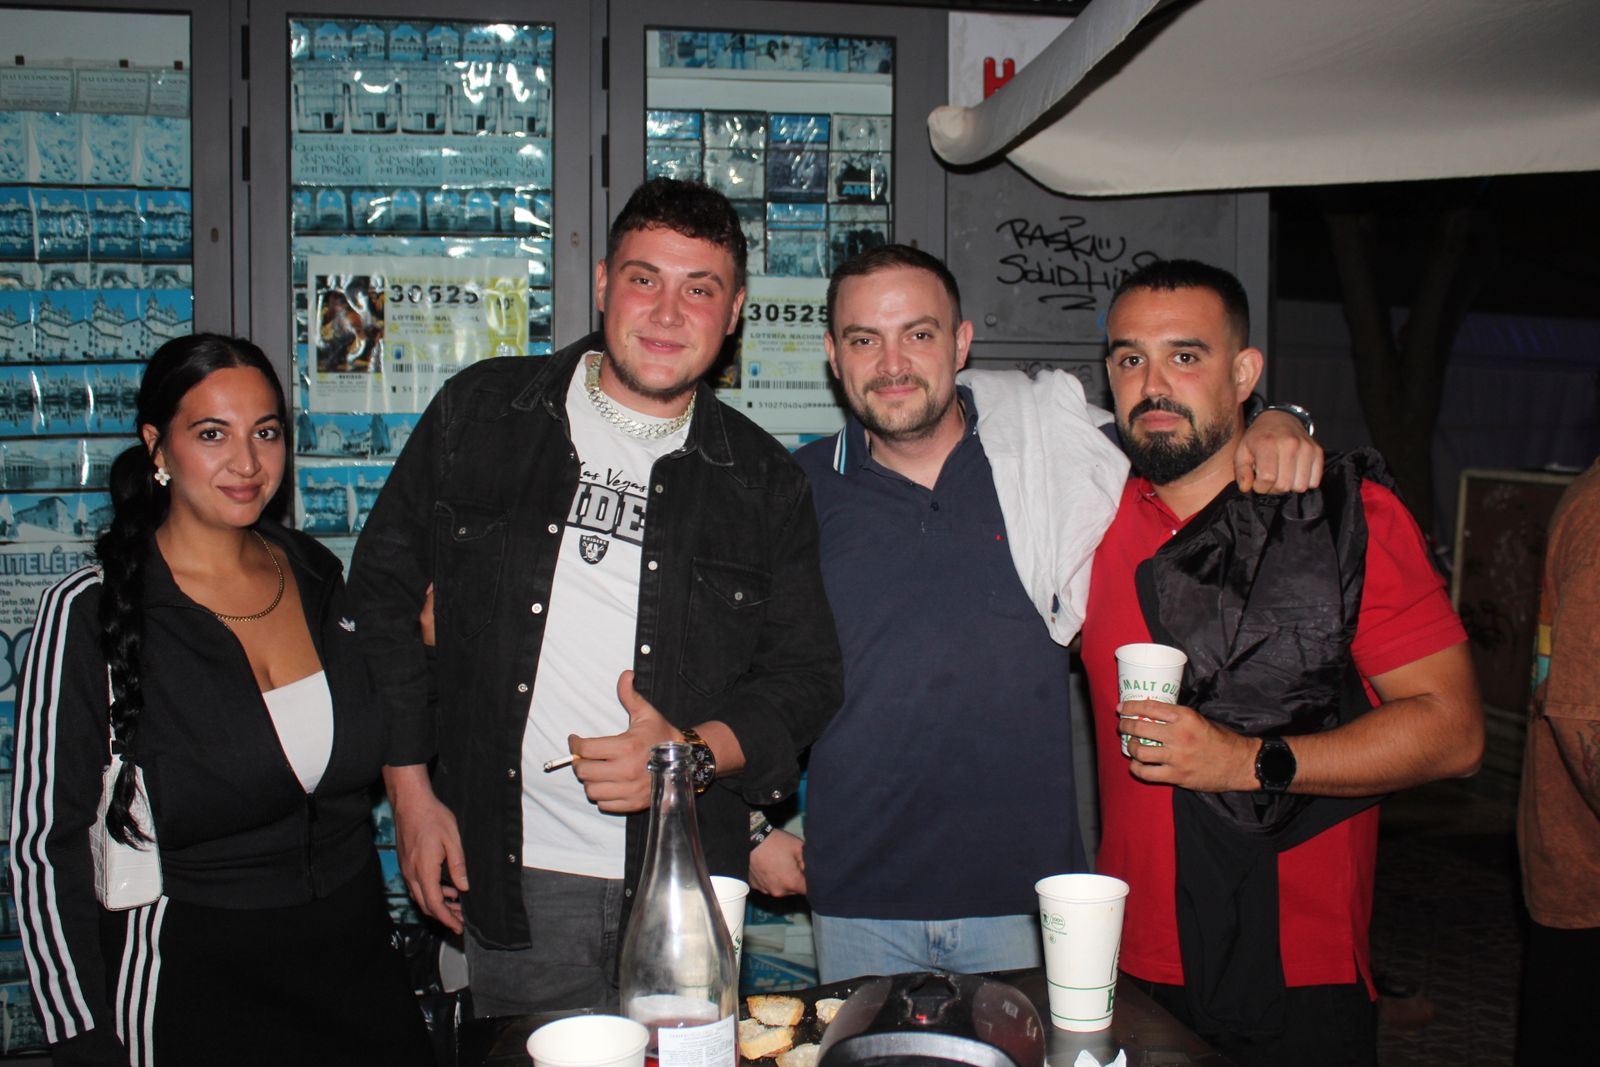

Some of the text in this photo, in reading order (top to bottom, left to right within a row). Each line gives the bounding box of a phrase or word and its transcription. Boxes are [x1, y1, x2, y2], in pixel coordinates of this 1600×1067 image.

[389, 284, 479, 304] 30525
[748, 303, 829, 323] 30525
[606, 467, 648, 495] Vegas
[1123, 679, 1158, 692] MALT
